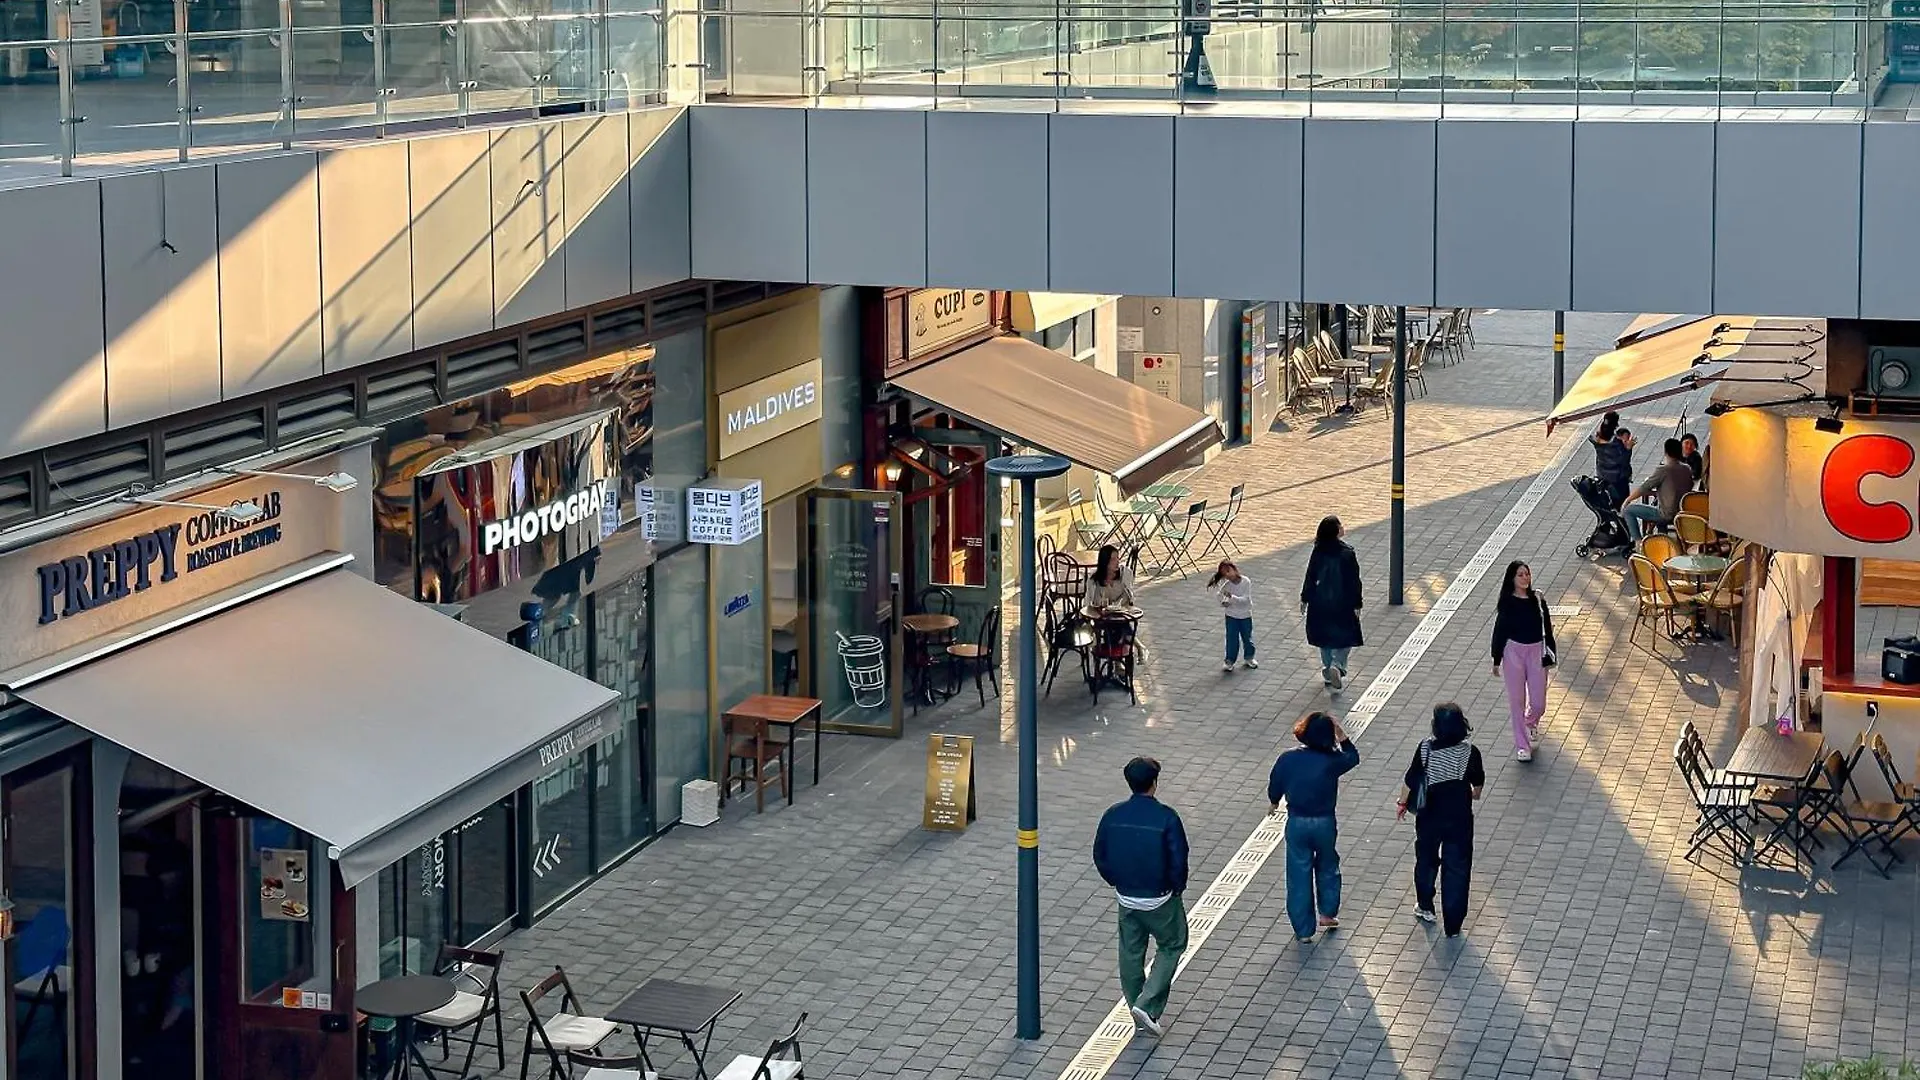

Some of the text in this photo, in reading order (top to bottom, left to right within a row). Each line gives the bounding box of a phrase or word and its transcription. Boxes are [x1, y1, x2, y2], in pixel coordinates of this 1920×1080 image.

[934, 288, 966, 319] CUPI
[727, 381, 815, 435] MALDIVES
[1820, 433, 1920, 544] C
[479, 479, 608, 556] PHOTOGRAY
[692, 525, 732, 535] COFFEE
[37, 522, 182, 626] PREPPY
[539, 731, 575, 767] PREPPY
